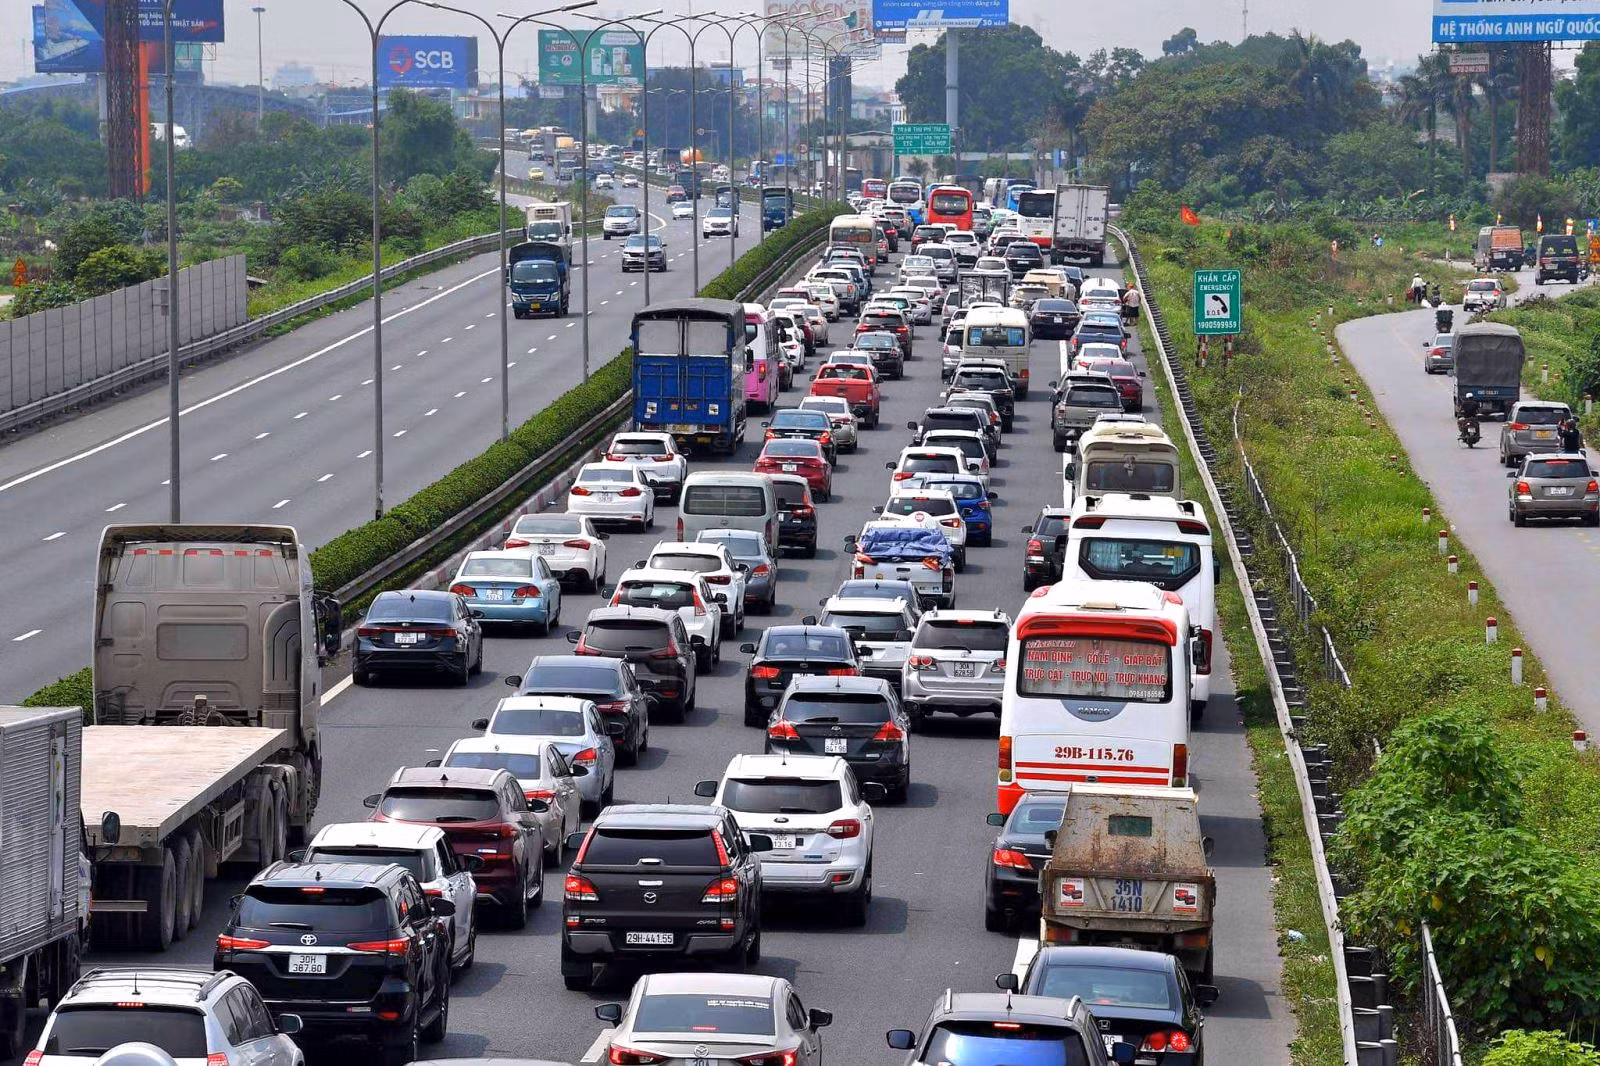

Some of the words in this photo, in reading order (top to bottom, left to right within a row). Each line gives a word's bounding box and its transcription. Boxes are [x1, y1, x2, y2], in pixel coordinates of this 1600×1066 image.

[1440, 20, 1456, 38] HỆ
[1459, 18, 1503, 36] THỐNG
[1505, 22, 1533, 35] ANH
[1536, 18, 1565, 34] NGỮ
[415, 50, 454, 69] SCB
[1028, 650, 1048, 662] NAM
[1138, 673, 1167, 685] KHANG
[1055, 746, 1134, 761] 29B-115.76
[627, 932, 673, 944] 29H-441.55
